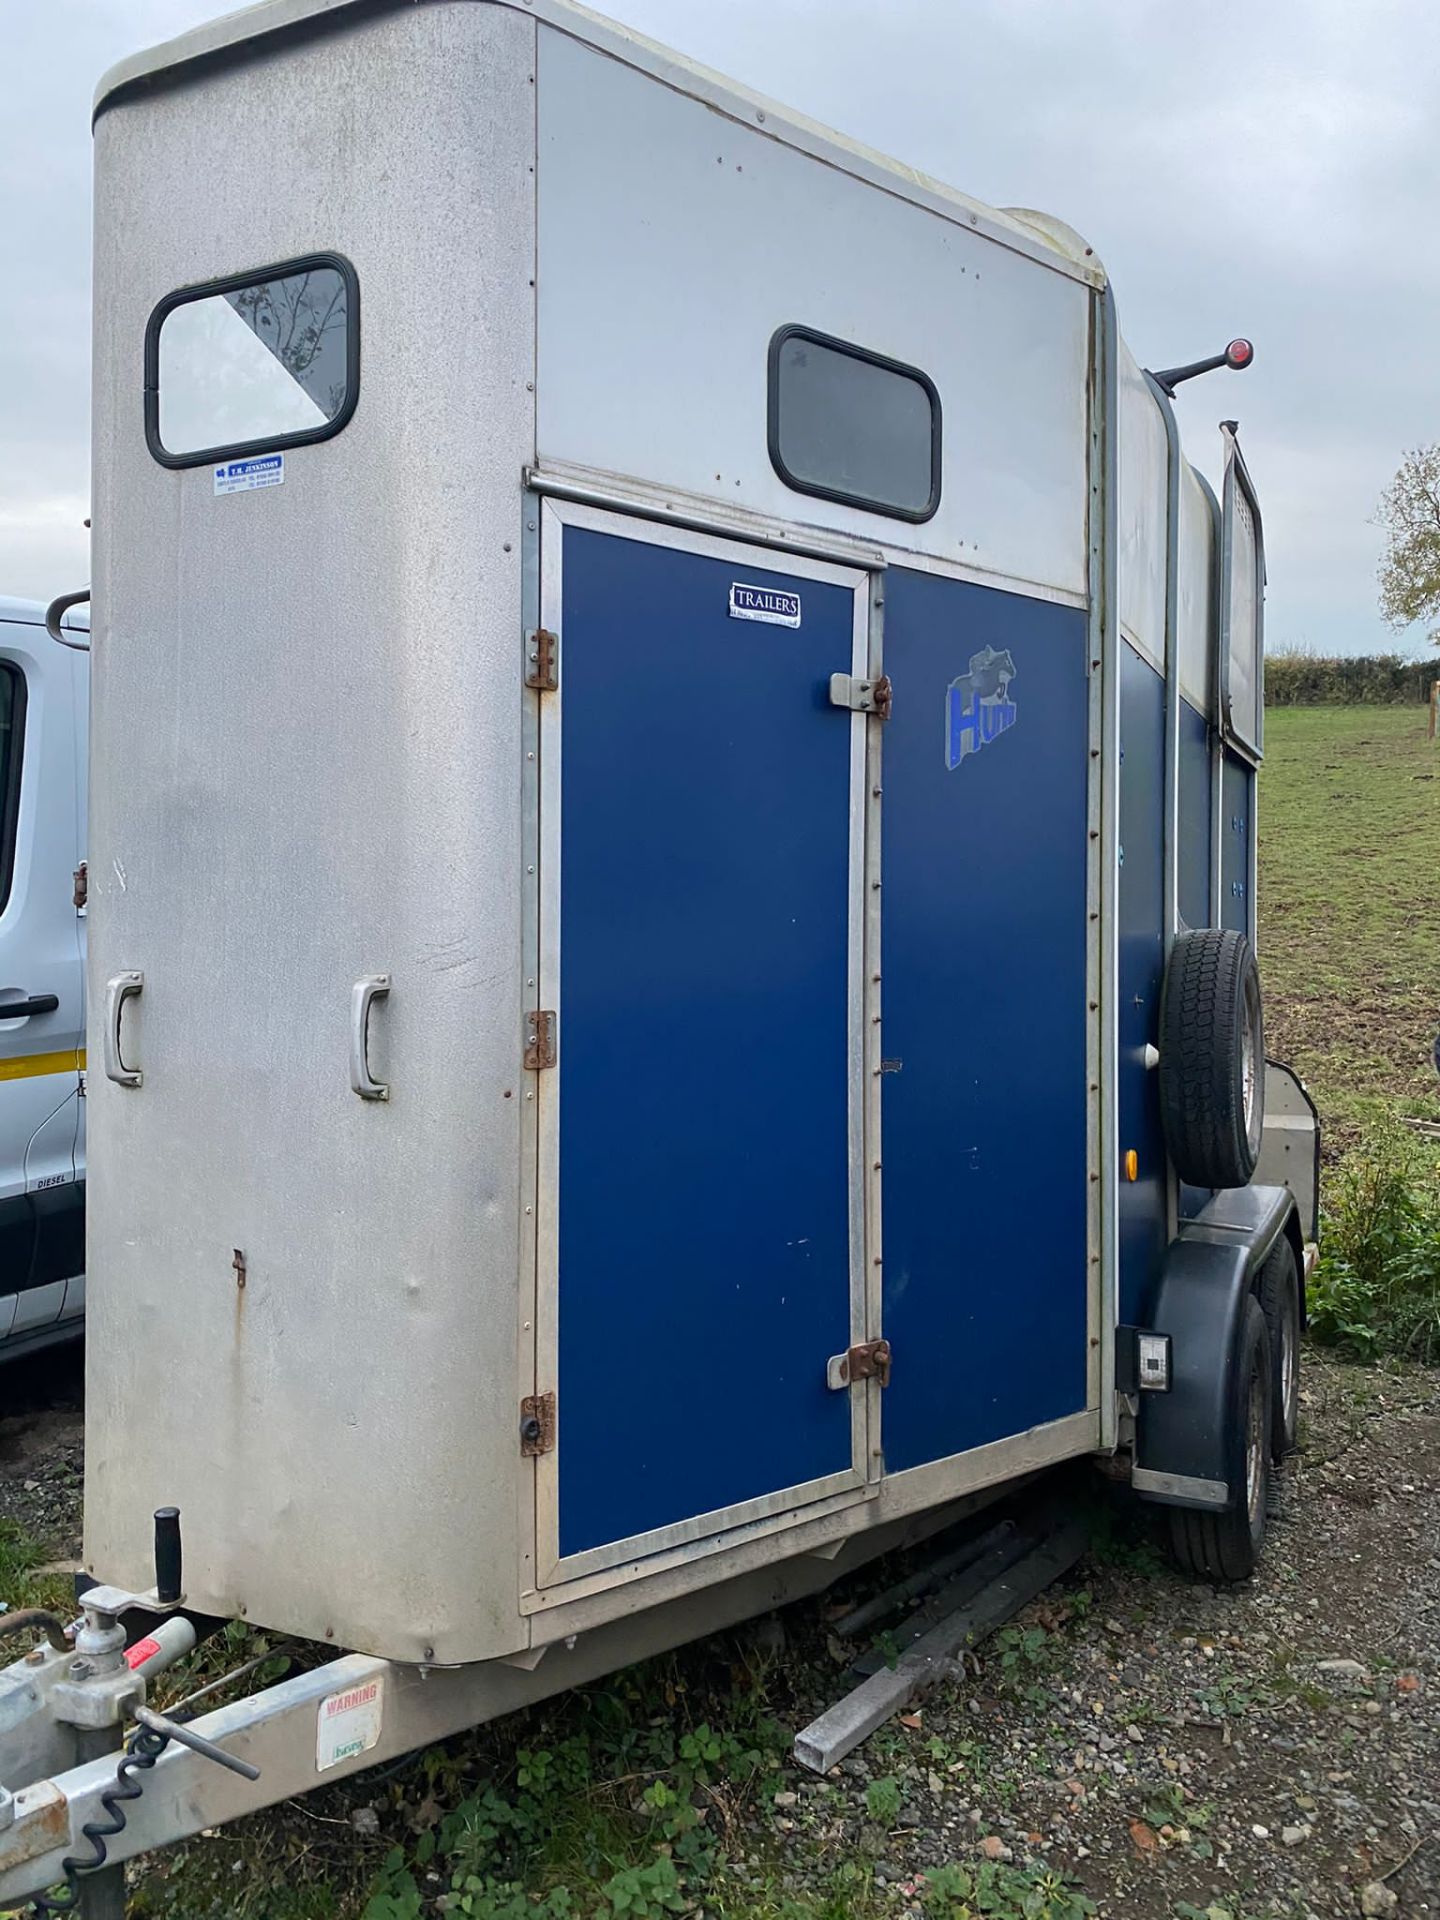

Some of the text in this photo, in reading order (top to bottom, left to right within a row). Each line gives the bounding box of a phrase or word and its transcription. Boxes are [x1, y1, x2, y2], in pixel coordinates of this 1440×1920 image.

[735, 589, 797, 614] TRAILERS
[37, 1174, 66, 1189] DIESEL
[327, 1684, 377, 1715] WARNING
